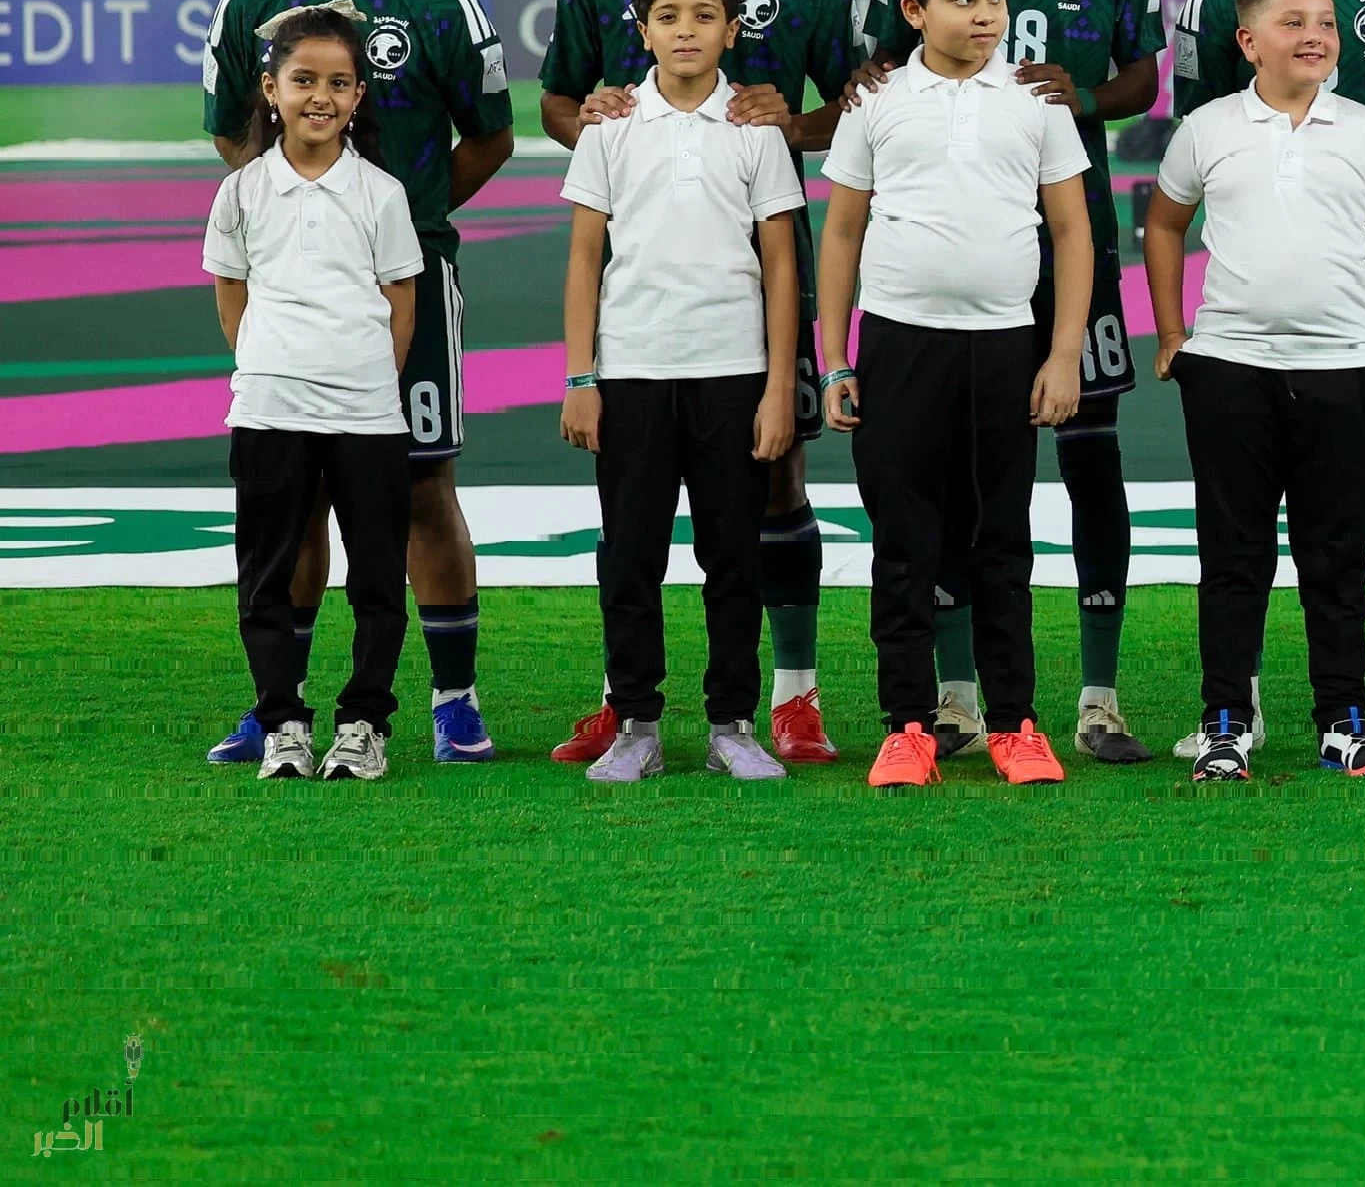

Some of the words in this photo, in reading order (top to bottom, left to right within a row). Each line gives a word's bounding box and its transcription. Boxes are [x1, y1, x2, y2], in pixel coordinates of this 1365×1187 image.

[1057, 2, 1080, 11] SAUDI
[741, 30, 764, 40] SAUDI
[372, 71, 396, 81] SAUDI
